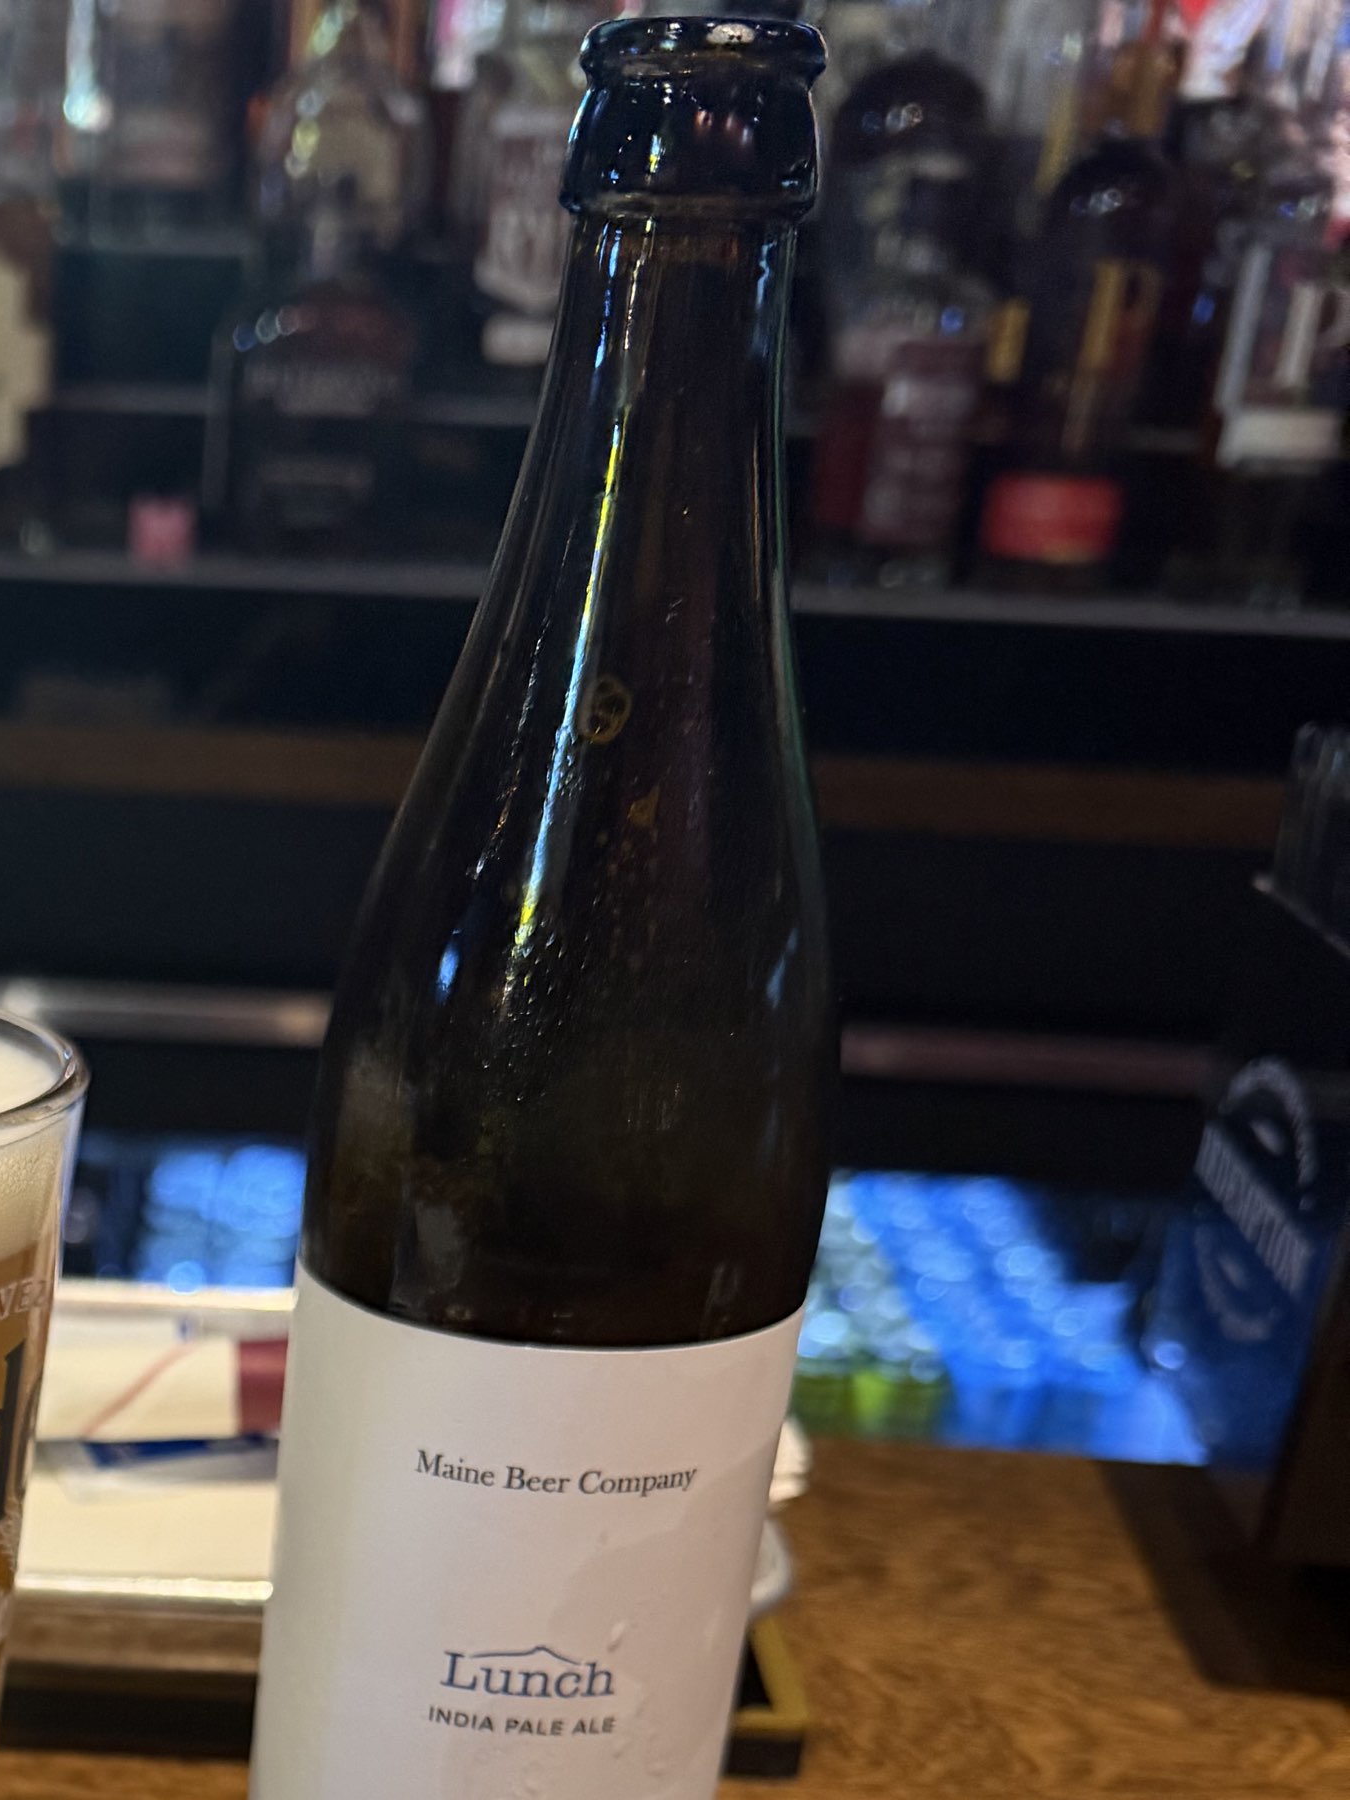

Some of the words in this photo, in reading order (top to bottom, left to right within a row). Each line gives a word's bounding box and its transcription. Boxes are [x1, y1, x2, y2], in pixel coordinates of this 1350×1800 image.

[414, 1449, 495, 1487] Maine
[502, 1465, 571, 1493] Beer
[578, 1467, 698, 1497] Company
[439, 1645, 616, 1699] Lunch
[428, 1705, 494, 1732] INDIA
[504, 1716, 564, 1736] PALE
[571, 1716, 616, 1736] ALE
